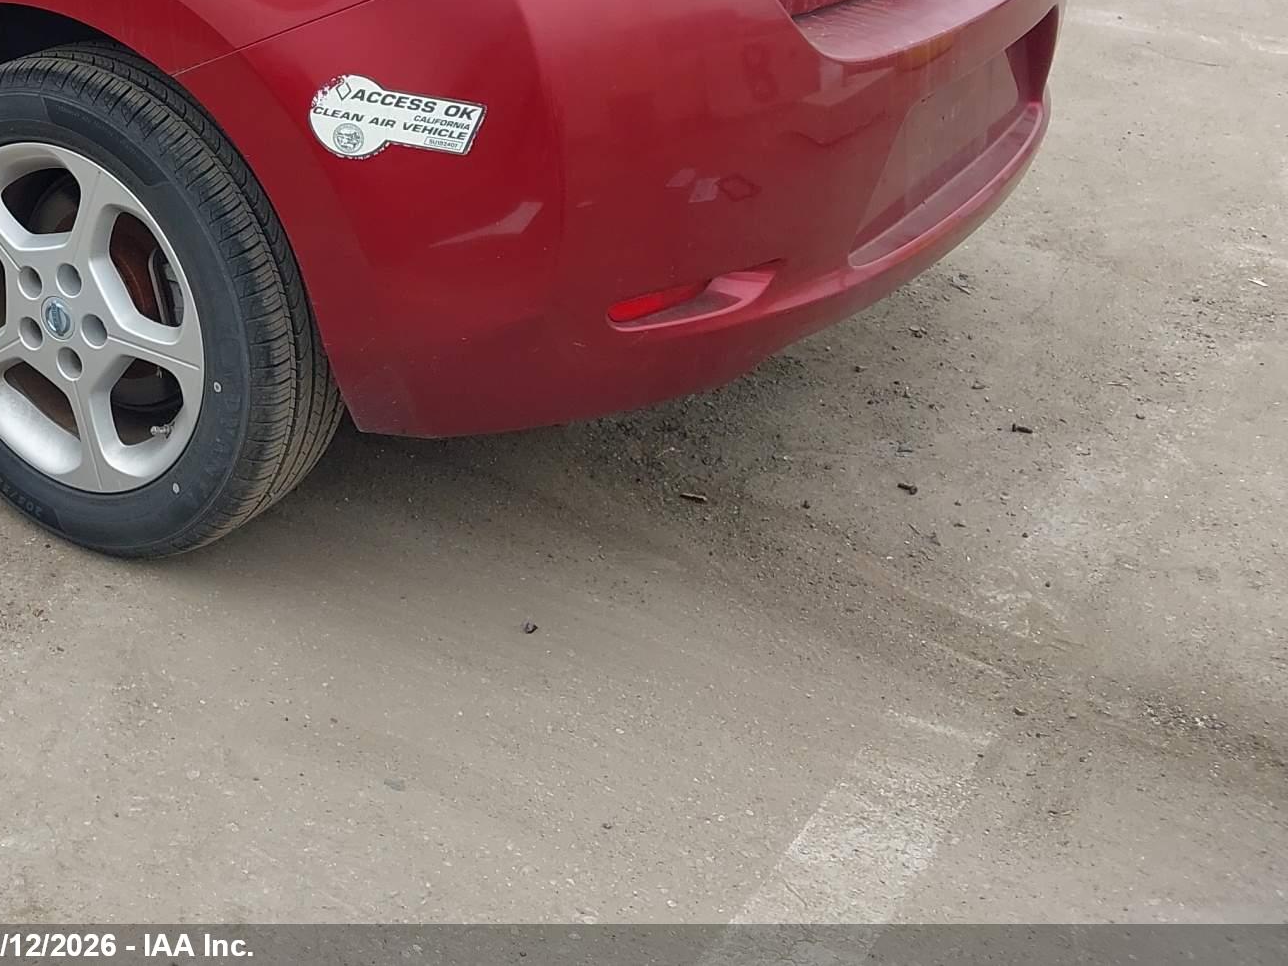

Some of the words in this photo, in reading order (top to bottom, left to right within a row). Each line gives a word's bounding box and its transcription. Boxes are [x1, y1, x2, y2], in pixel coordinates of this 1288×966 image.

[350, 89, 437, 114] ACCESS
[444, 105, 478, 121] OK
[313, 106, 364, 122] CLEAN
[368, 117, 396, 128] AIR
[403, 122, 469, 141] VEHICLE
[414, 115, 470, 130] CALIFORNIA
